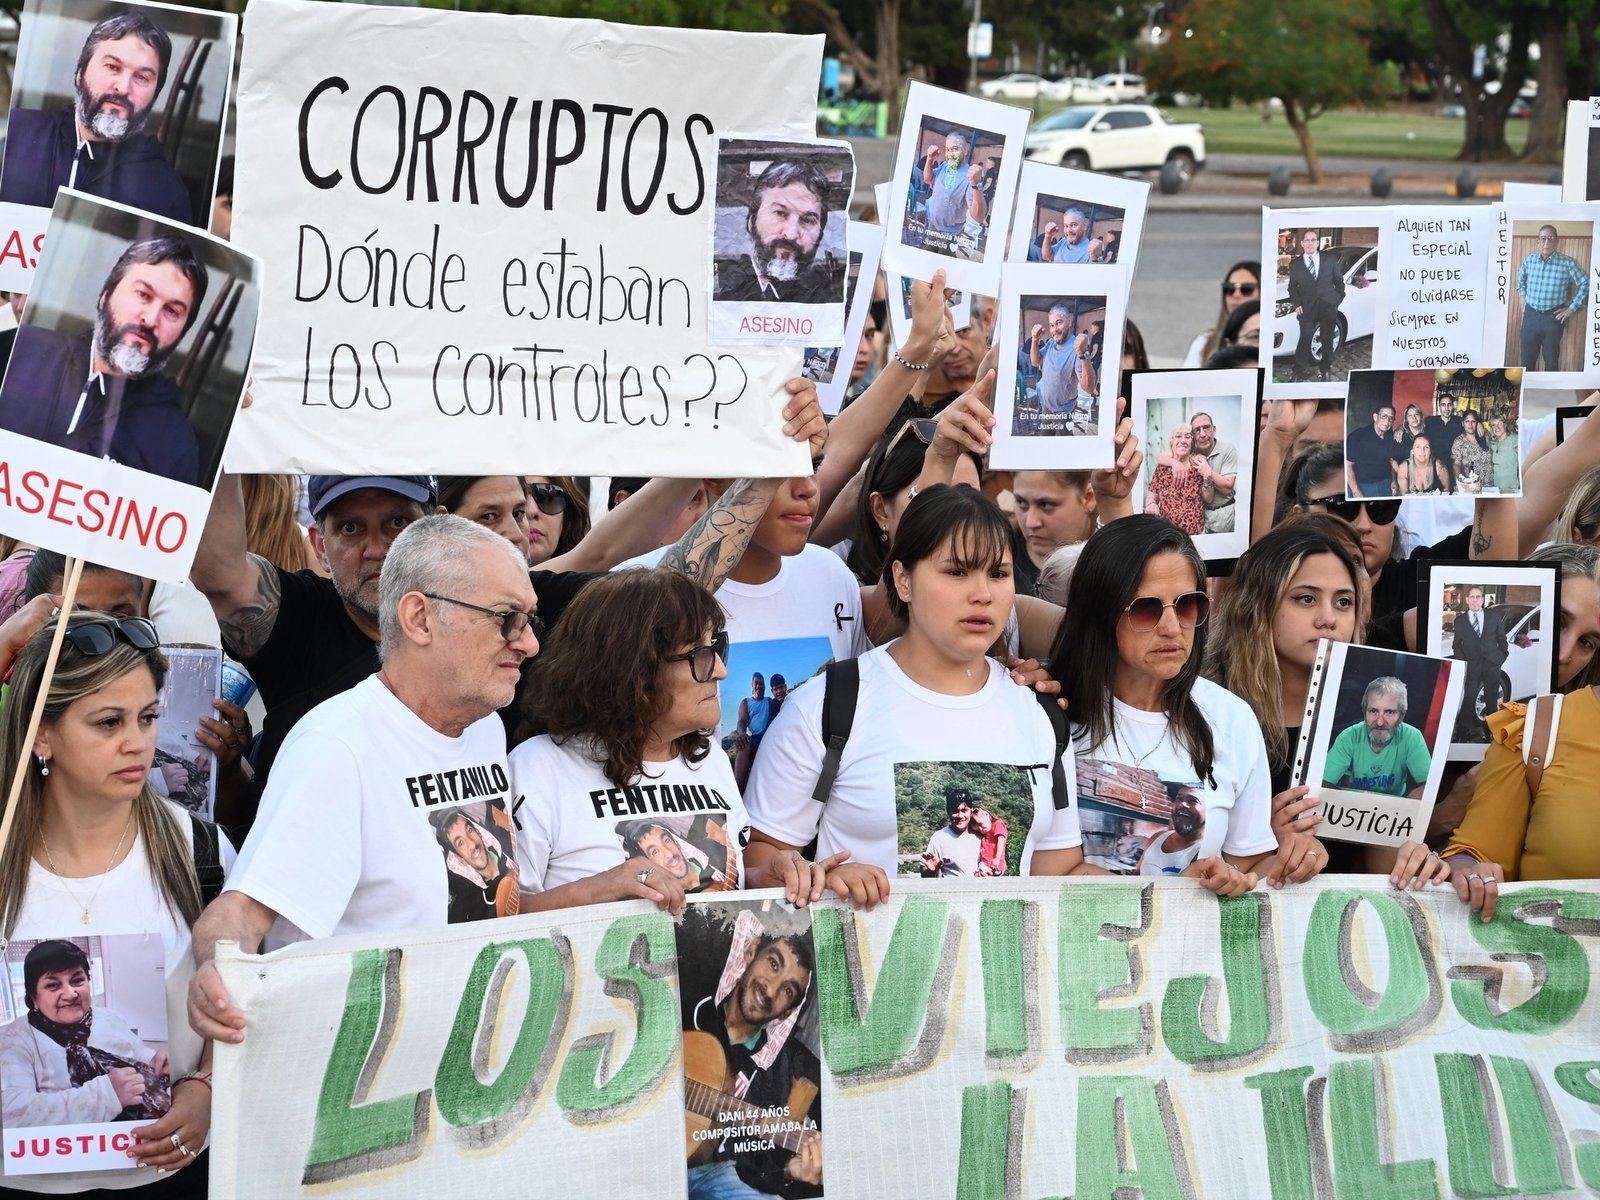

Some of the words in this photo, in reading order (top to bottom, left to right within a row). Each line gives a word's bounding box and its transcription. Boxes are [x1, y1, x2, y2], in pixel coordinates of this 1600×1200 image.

[298, 76, 714, 215] CORRUPTOS
[908, 223, 916, 233] En
[917, 226, 924, 235] tu
[924, 229, 953, 241] memoria
[1449, 218, 1471, 232] TAN
[922, 238, 948, 250] Justicia
[1496, 211, 1508, 305] HECTOR
[295, 223, 466, 313] Dónde
[503, 238, 690, 328] estaban
[1399, 268, 1416, 281] NO
[1420, 269, 1461, 285] PUEDE
[739, 316, 813, 335] ASESINO
[1445, 311, 1459, 324] EN
[432, 343, 748, 430] controles??
[1019, 412, 1029, 420] En
[1030, 412, 1038, 420] tu
[1038, 412, 1067, 420] memoria
[1038, 422, 1064, 430] Justicia
[589, 784, 731, 818] FENTANILO
[304, 913, 679, 1185] LOS
[812, 883, 1600, 1087] VIEJOS
[719, 1110, 745, 1123] DANI
[745, 1109, 759, 1120] 44
[761, 1105, 790, 1119] AÑOS
[692, 1125, 761, 1142] COMPOSITOR
[763, 1122, 802, 1135] AMABA
[803, 1119, 818, 1131] LA
[734, 1138, 776, 1153] MÚSICA
